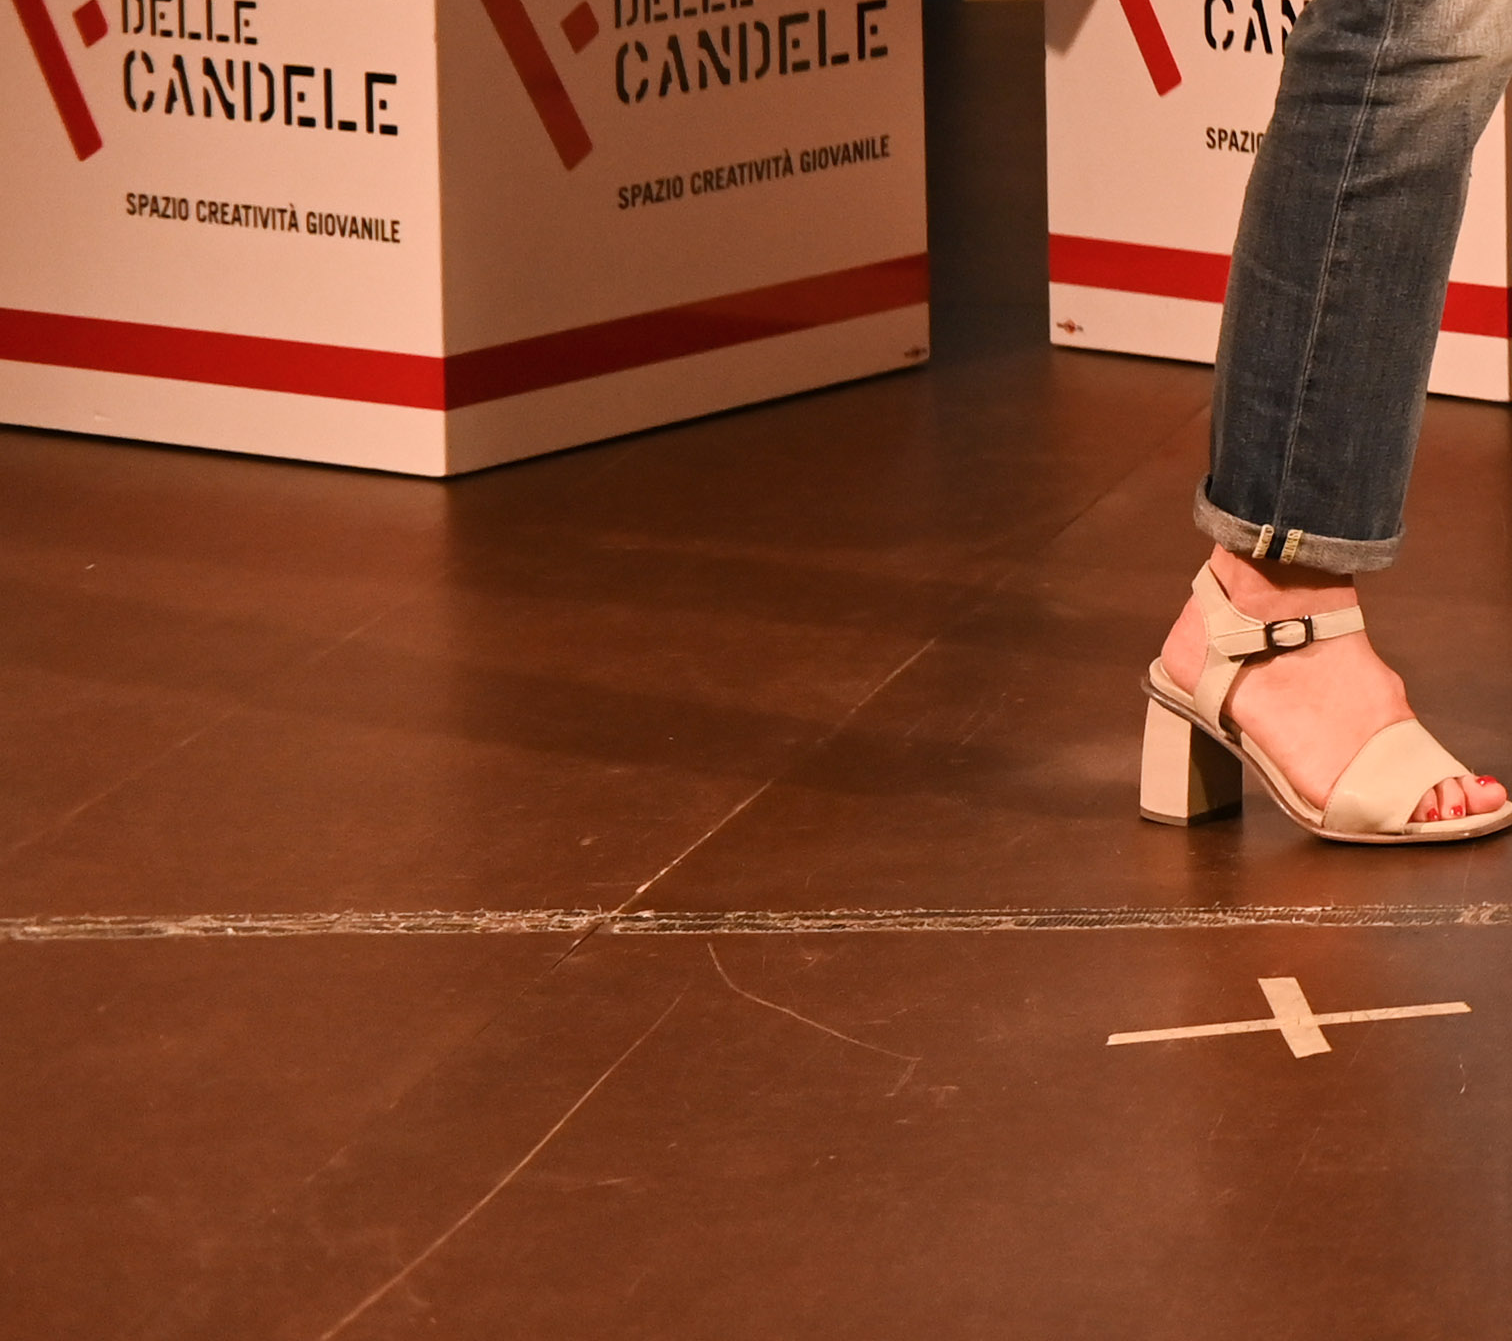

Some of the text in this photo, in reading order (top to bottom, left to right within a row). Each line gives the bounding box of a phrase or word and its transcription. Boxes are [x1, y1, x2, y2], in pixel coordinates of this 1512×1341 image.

[122, 49, 399, 137] CANDELE
[618, 134, 891, 211] SPAZIO CREATIVITÀ GIOVANILE
[125, 192, 401, 245] SPAZIO CREATIVITÀ GIOVANILE
